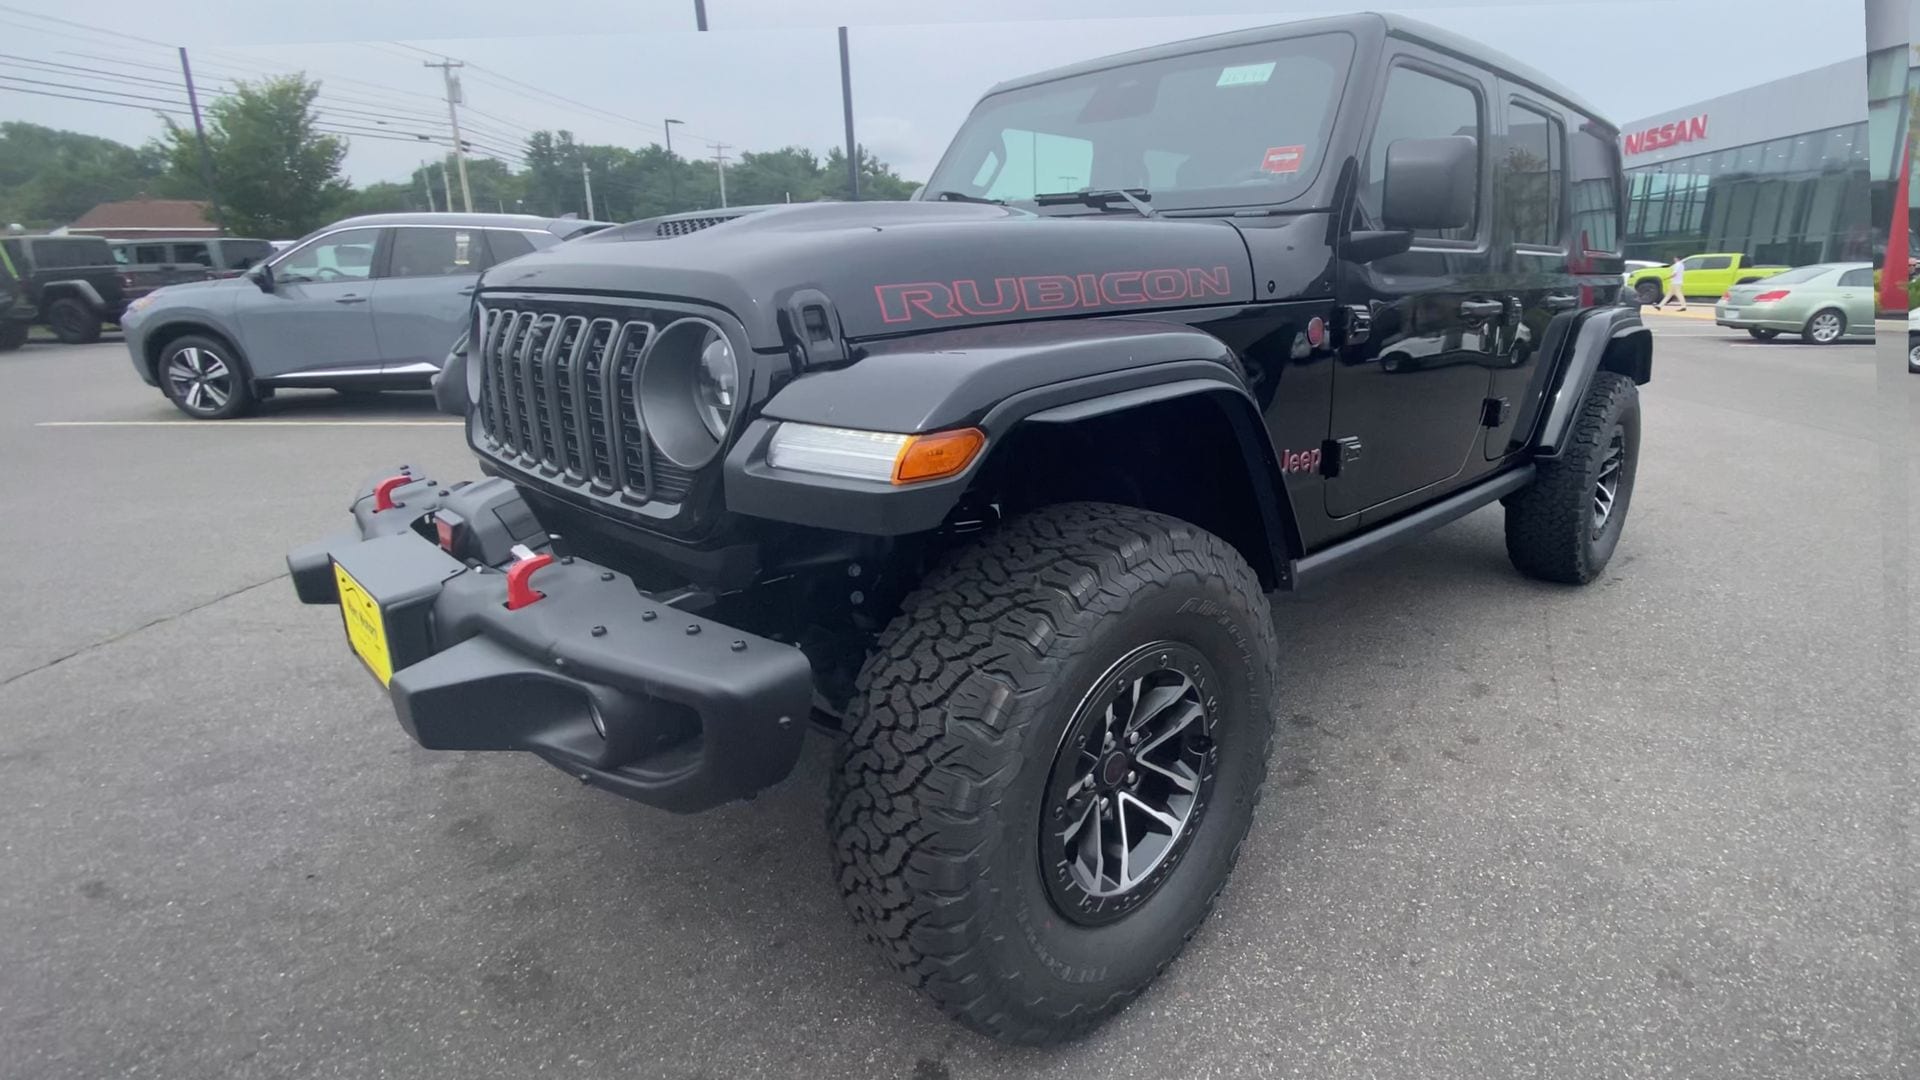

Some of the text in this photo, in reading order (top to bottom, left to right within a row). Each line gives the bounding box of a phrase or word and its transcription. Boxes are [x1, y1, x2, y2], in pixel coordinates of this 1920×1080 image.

[1624, 113, 1708, 156] NISSAN
[874, 265, 1231, 323] RUBICON
[1281, 448, 1321, 473] Jeep
